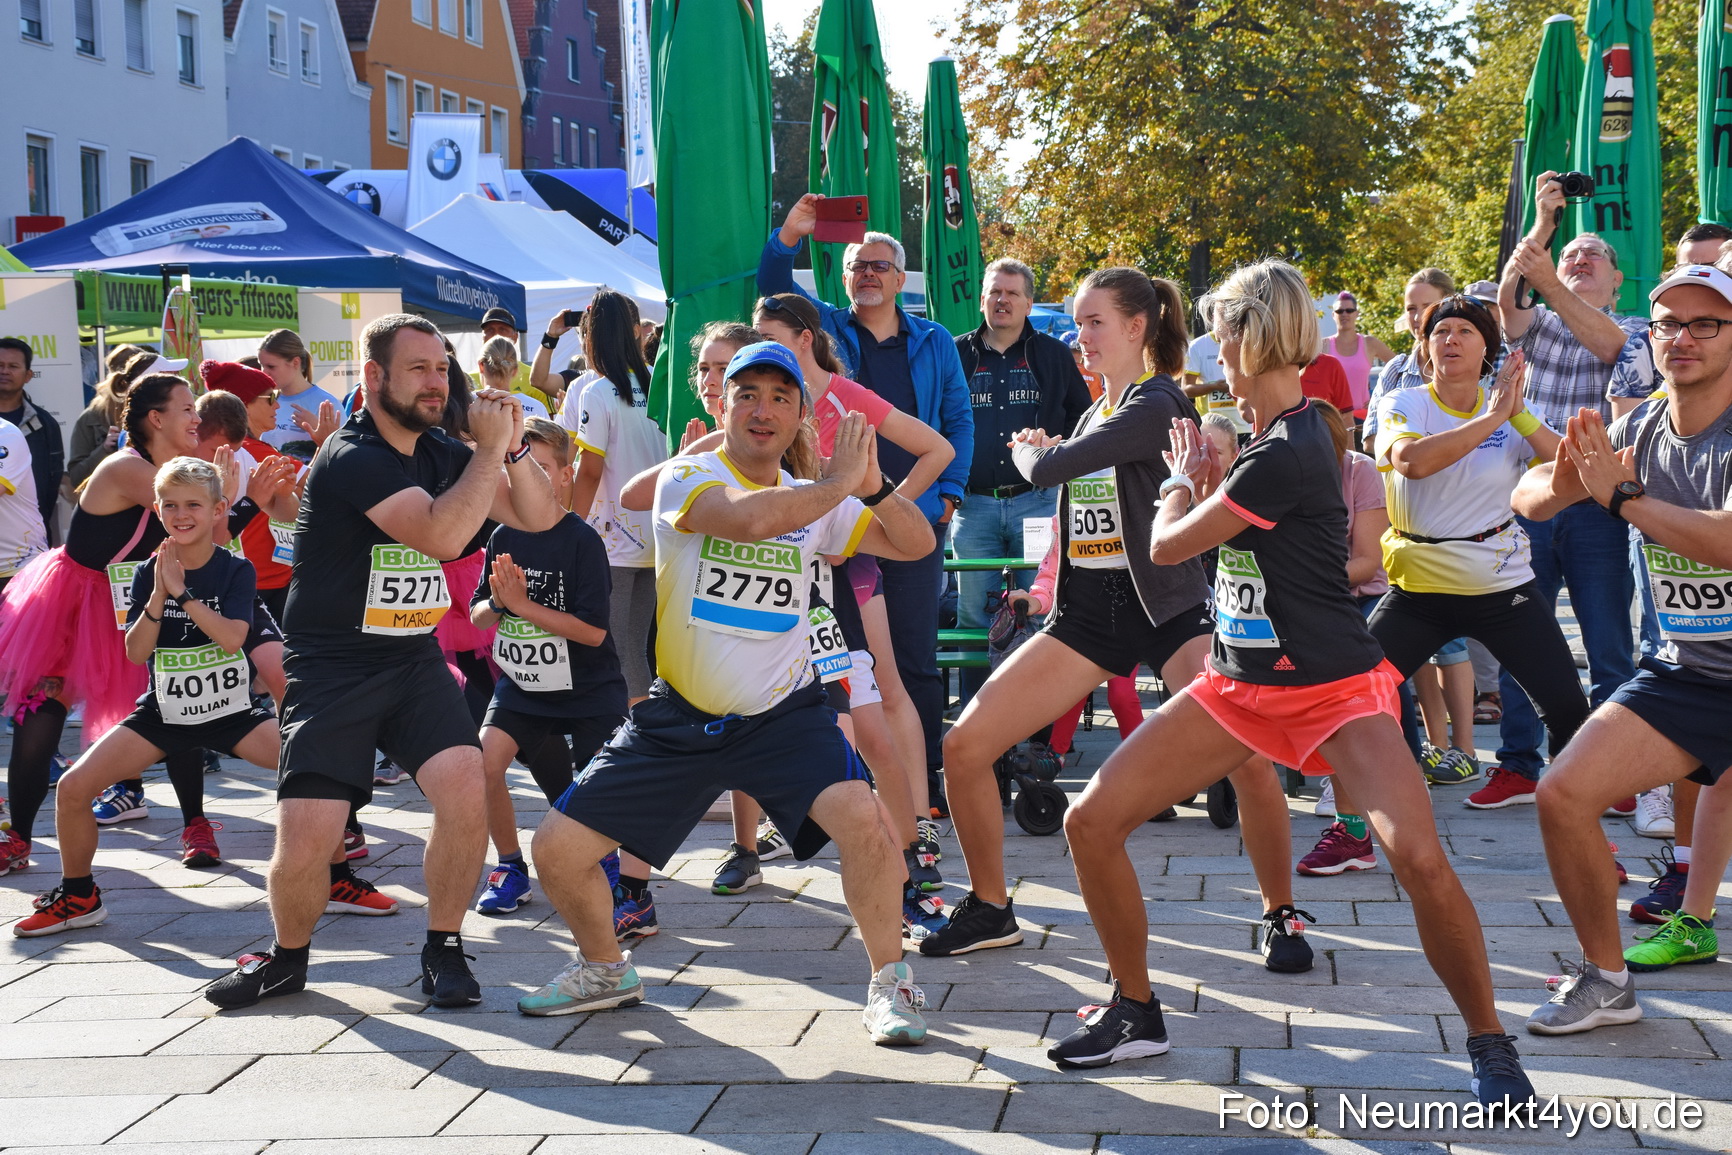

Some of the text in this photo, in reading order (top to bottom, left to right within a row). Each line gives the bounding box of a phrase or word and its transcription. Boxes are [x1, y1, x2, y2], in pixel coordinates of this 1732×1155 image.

[193, 241, 225, 249] Hier
[226, 243, 258, 251] lebe
[310, 340, 354, 362] POWER
[971, 392, 993, 404] TIME
[710, 538, 793, 568] BOCK
[1077, 541, 1124, 555] VICTOR
[380, 575, 441, 605] 5277
[705, 567, 793, 608] 2779
[393, 611, 432, 628] MARC
[1221, 620, 1247, 636] ULIA
[498, 639, 559, 666] 4020
[167, 667, 240, 699] 4018
[515, 671, 540, 683] MAX
[180, 697, 230, 717] JULIAN
